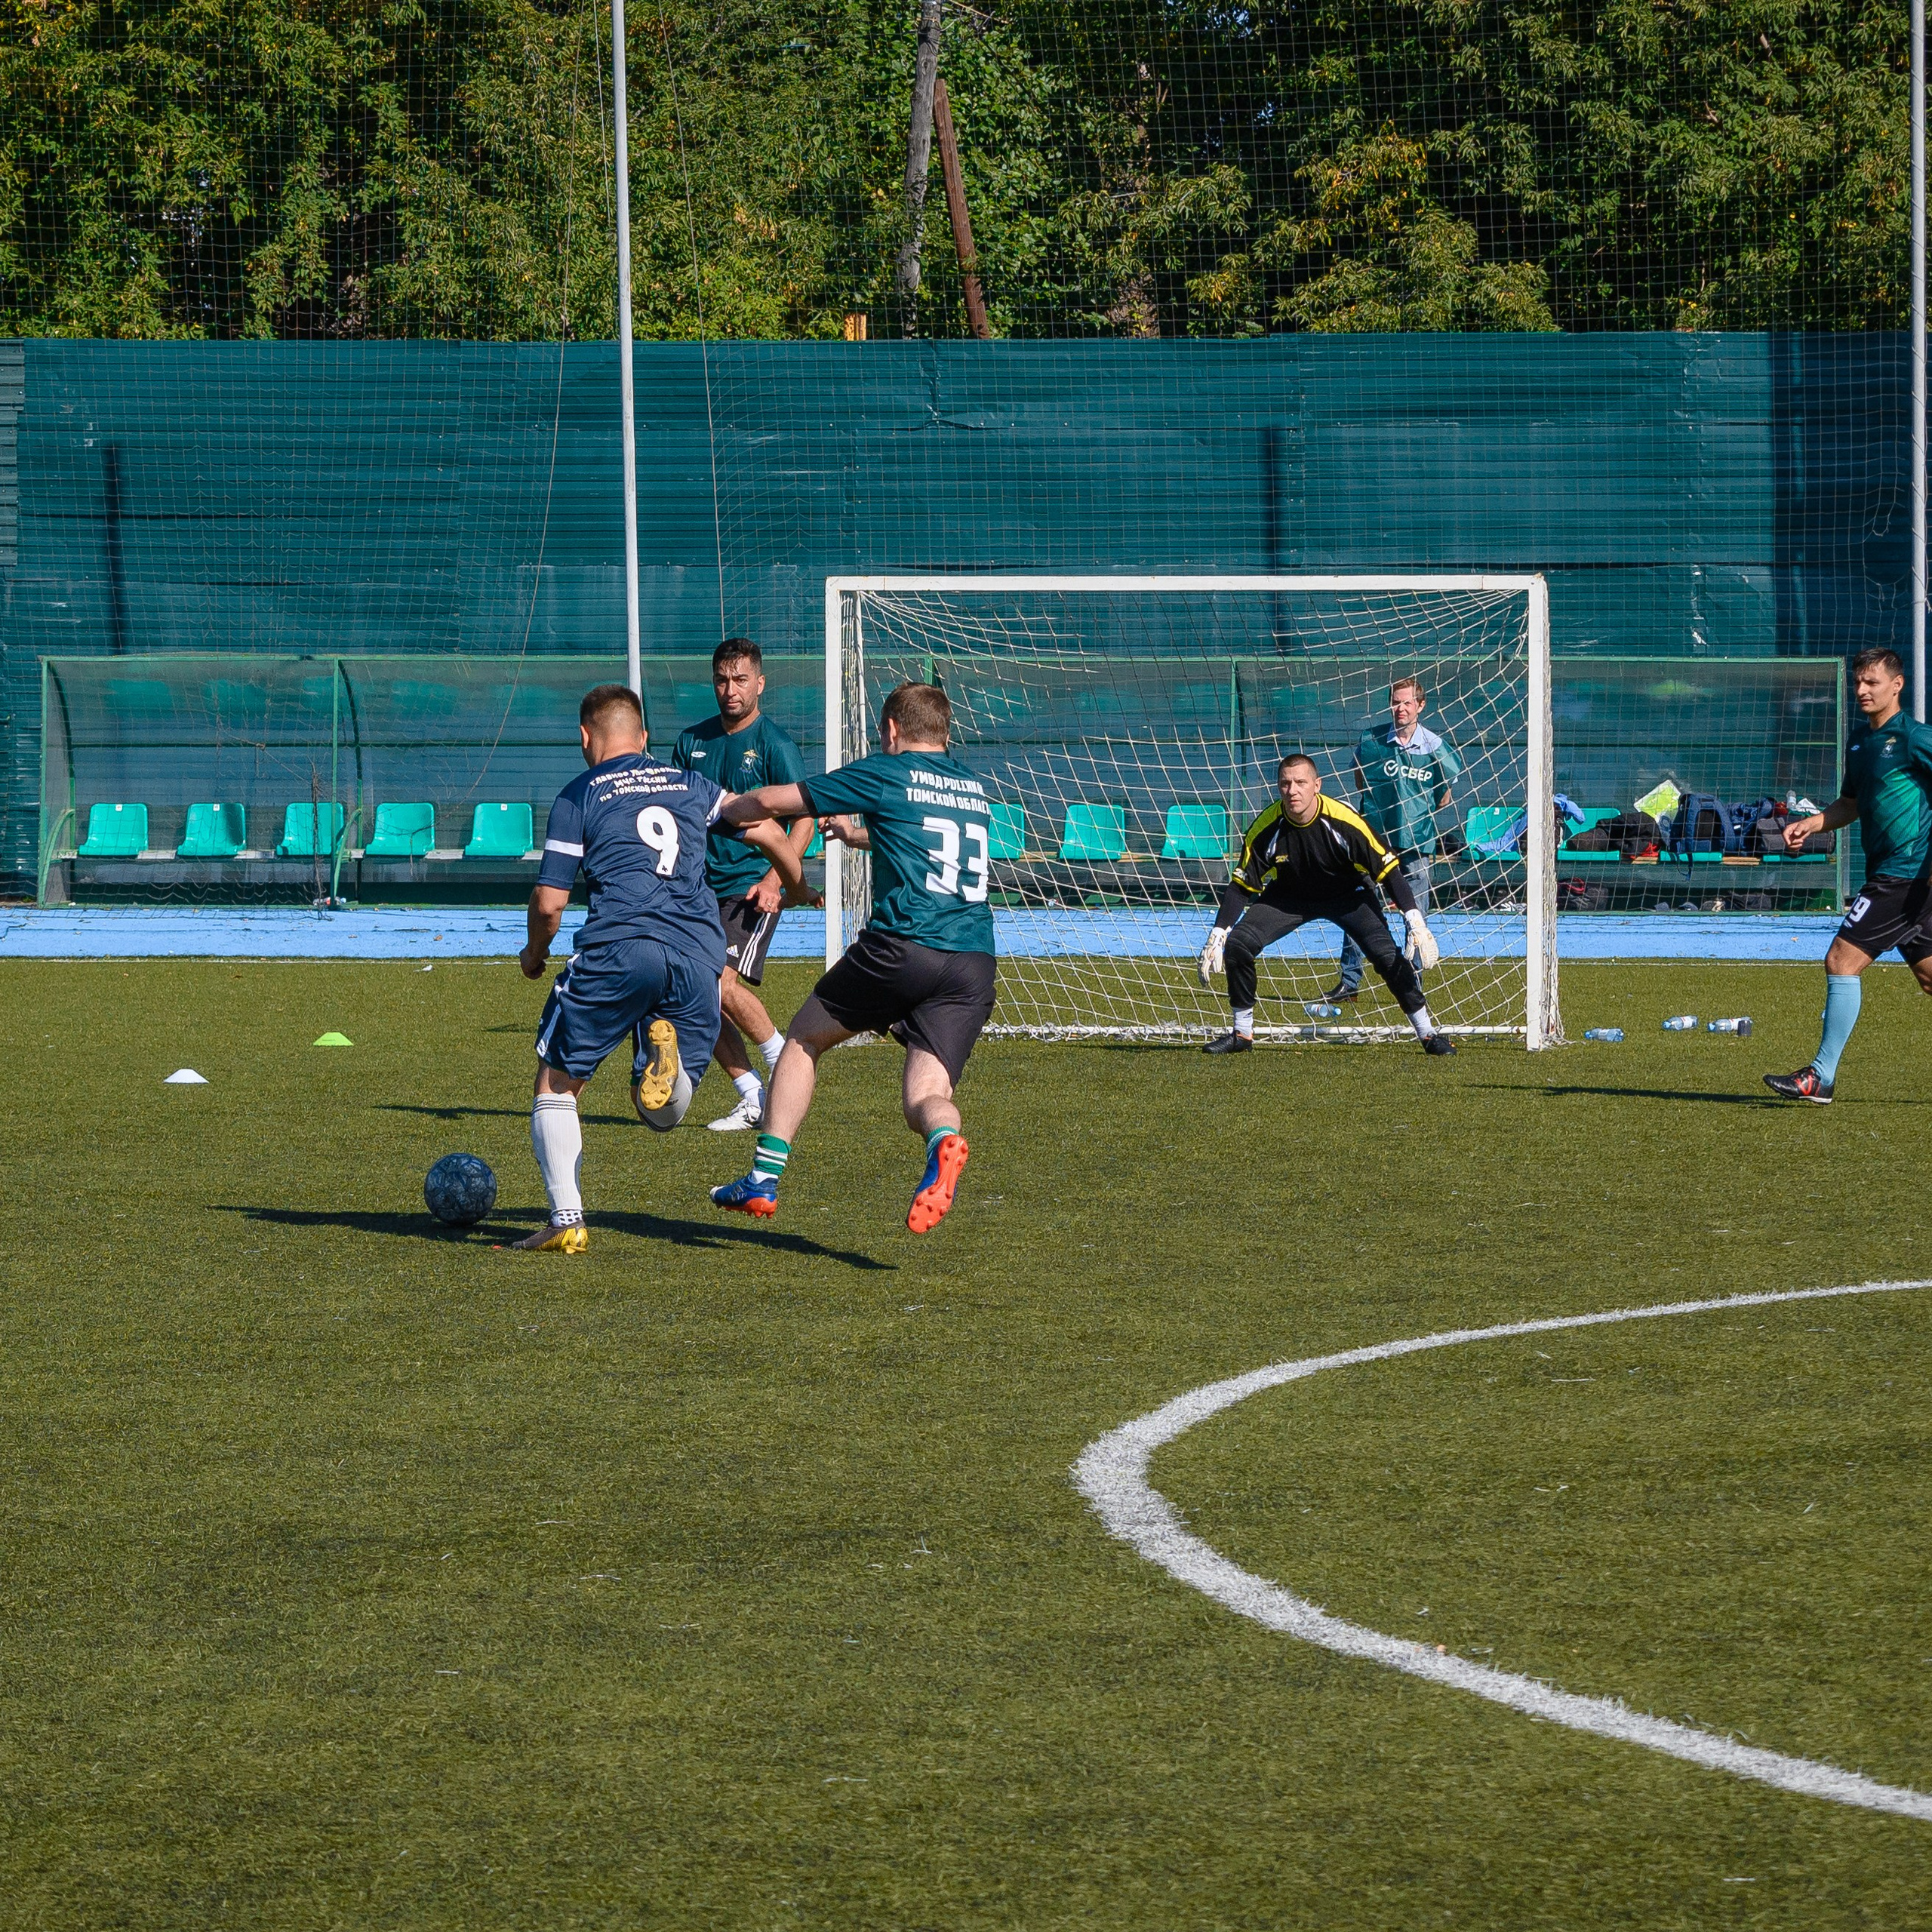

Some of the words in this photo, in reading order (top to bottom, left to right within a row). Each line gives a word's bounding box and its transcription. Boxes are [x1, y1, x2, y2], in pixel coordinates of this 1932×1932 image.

[909, 770, 943, 790] УМВД
[1400, 765, 1433, 782] СБЕР
[906, 787, 957, 808] ТОМСКОЙ
[636, 805, 679, 875] 9
[922, 817, 989, 902] 33
[1849, 894, 1871, 922] 9
